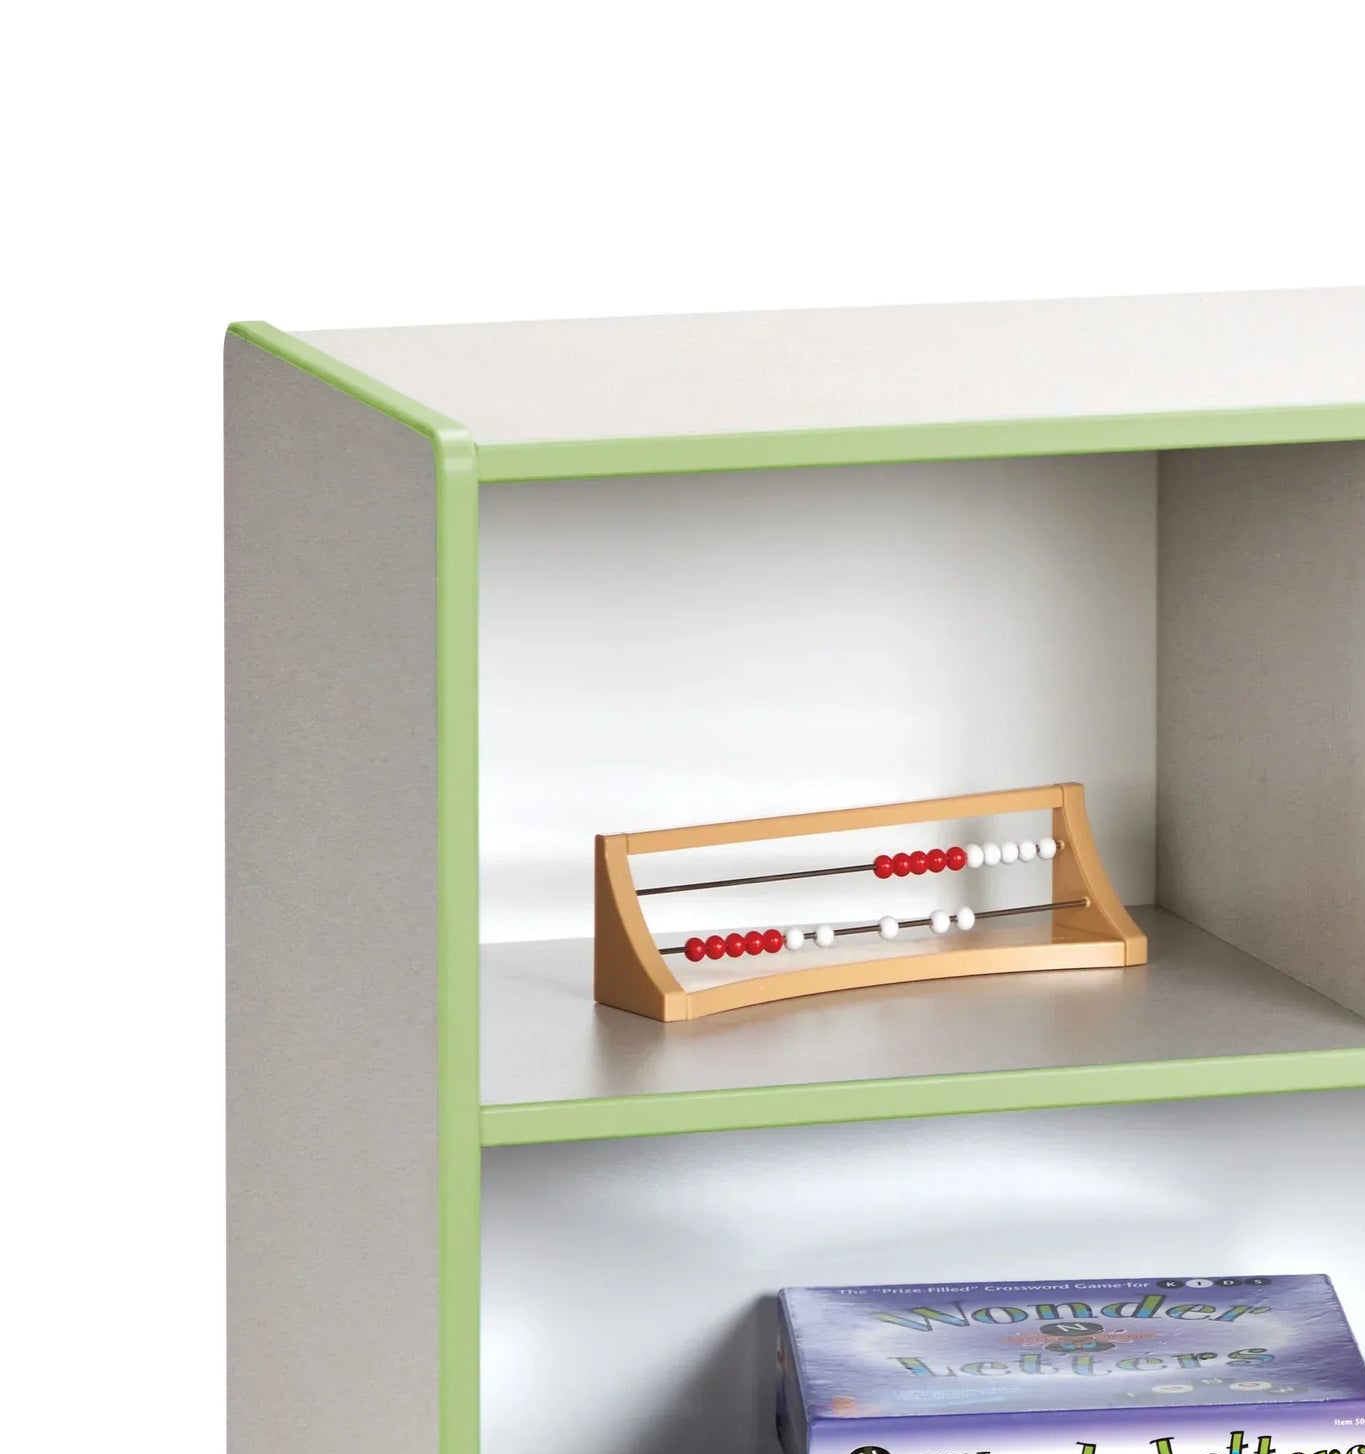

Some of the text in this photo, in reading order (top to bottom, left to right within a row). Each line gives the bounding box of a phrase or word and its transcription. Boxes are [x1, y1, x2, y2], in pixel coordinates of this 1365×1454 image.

[984, 1282, 1070, 1292] Crossword
[1074, 1282, 1121, 1290] Game
[1126, 1281, 1150, 1289] for
[868, 1294, 1273, 1332] Wonder
[887, 1347, 1277, 1378] Letters
[1335, 1418, 1353, 1426] Item
